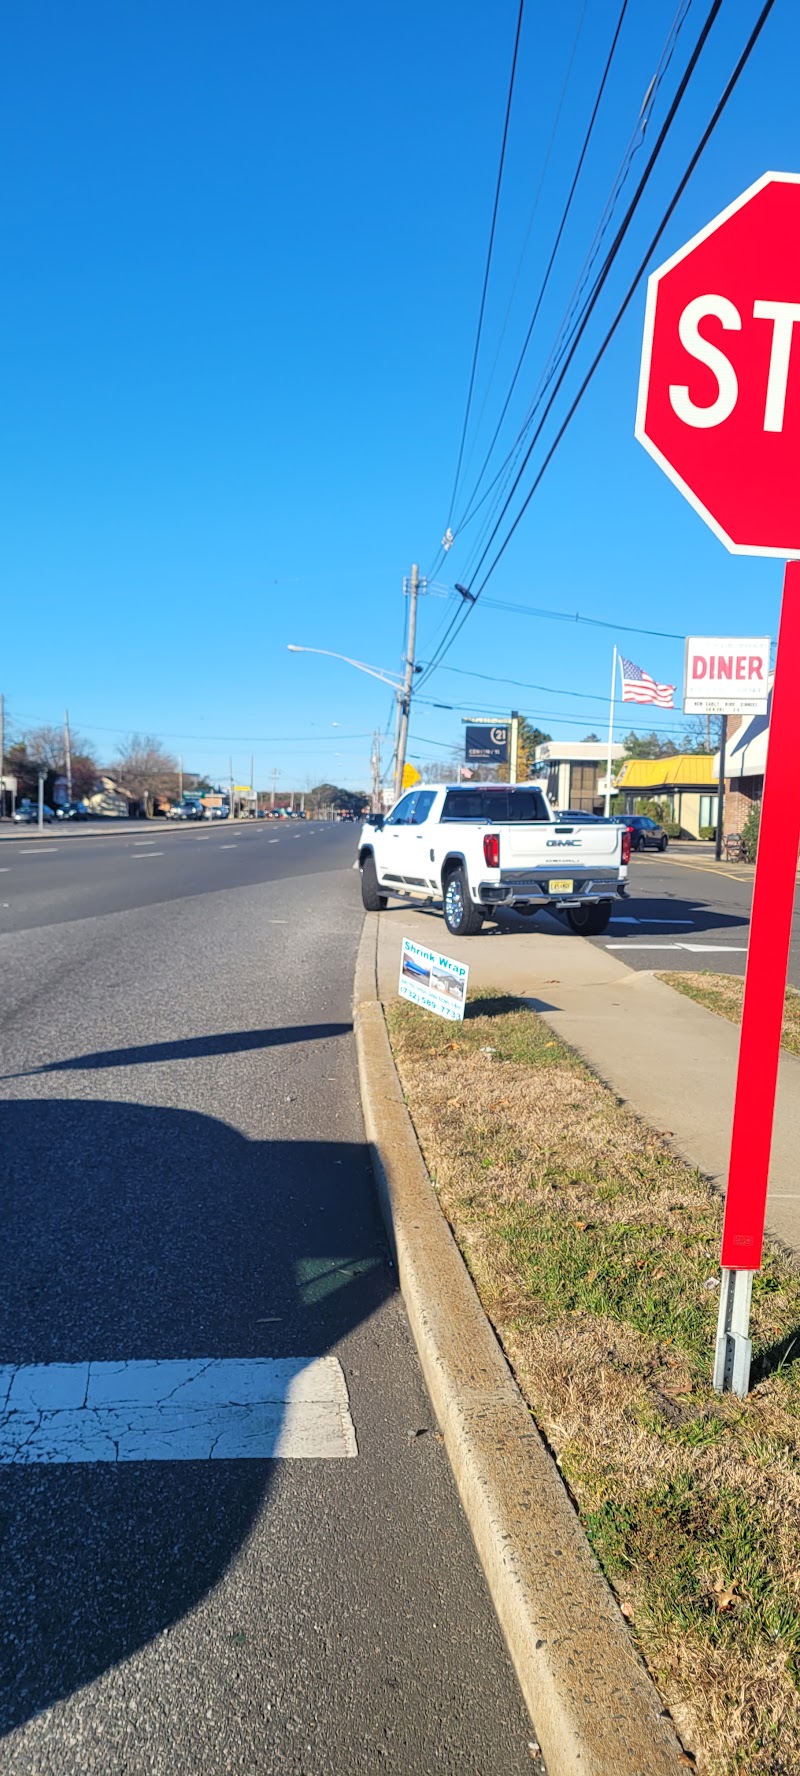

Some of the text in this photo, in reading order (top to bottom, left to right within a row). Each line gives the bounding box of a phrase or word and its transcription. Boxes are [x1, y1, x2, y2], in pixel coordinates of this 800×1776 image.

[692, 655, 764, 680] DINER
[546, 839, 582, 847] GMC
[405, 941, 466, 976] Shrink Wrap
